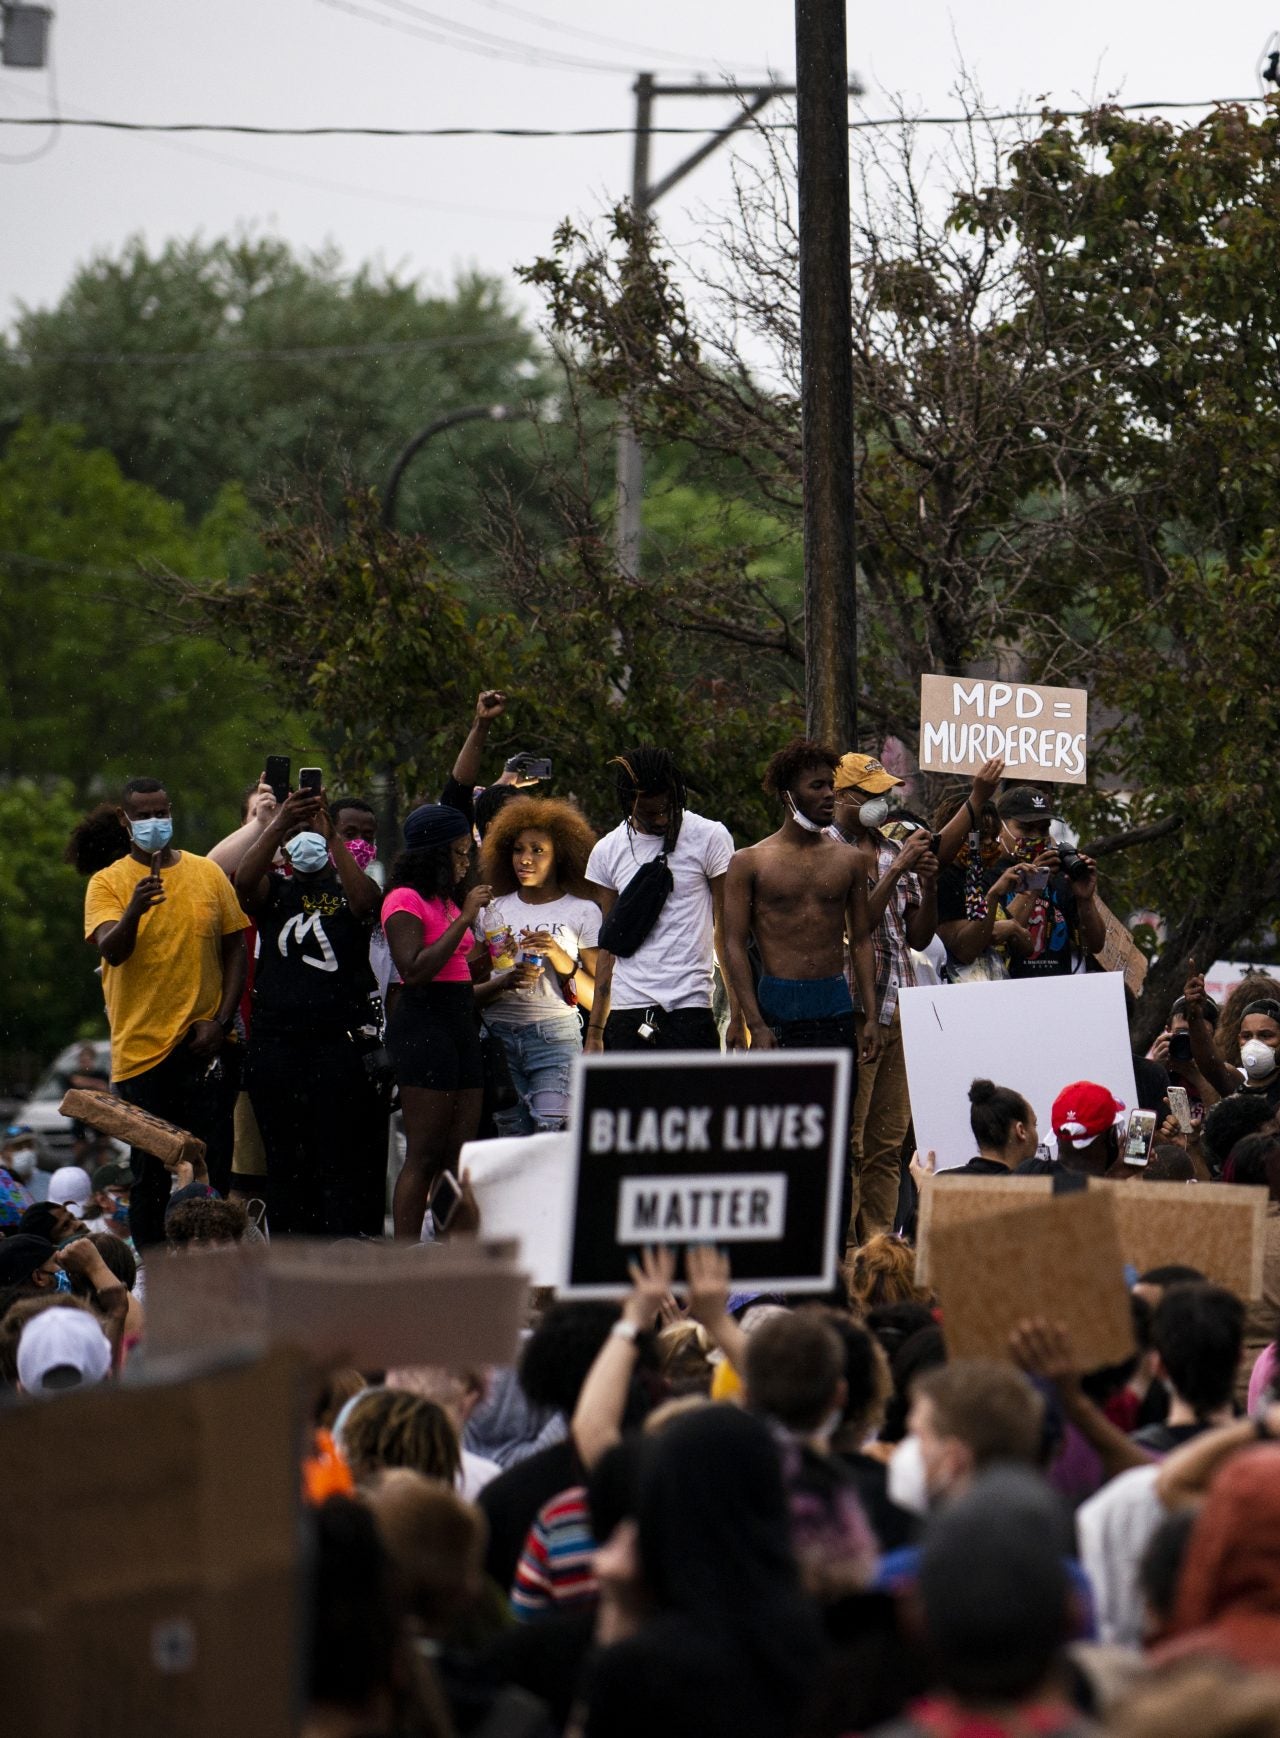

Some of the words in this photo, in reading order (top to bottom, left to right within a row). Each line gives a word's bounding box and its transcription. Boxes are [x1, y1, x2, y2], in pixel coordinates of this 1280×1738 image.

[953, 682, 1044, 718] MPD
[1053, 702, 1072, 718] =
[924, 720, 1086, 775] MURDERERS
[588, 1105, 713, 1154] BLACK
[721, 1102, 826, 1150] LIVES
[632, 1189, 771, 1230] MATTER
